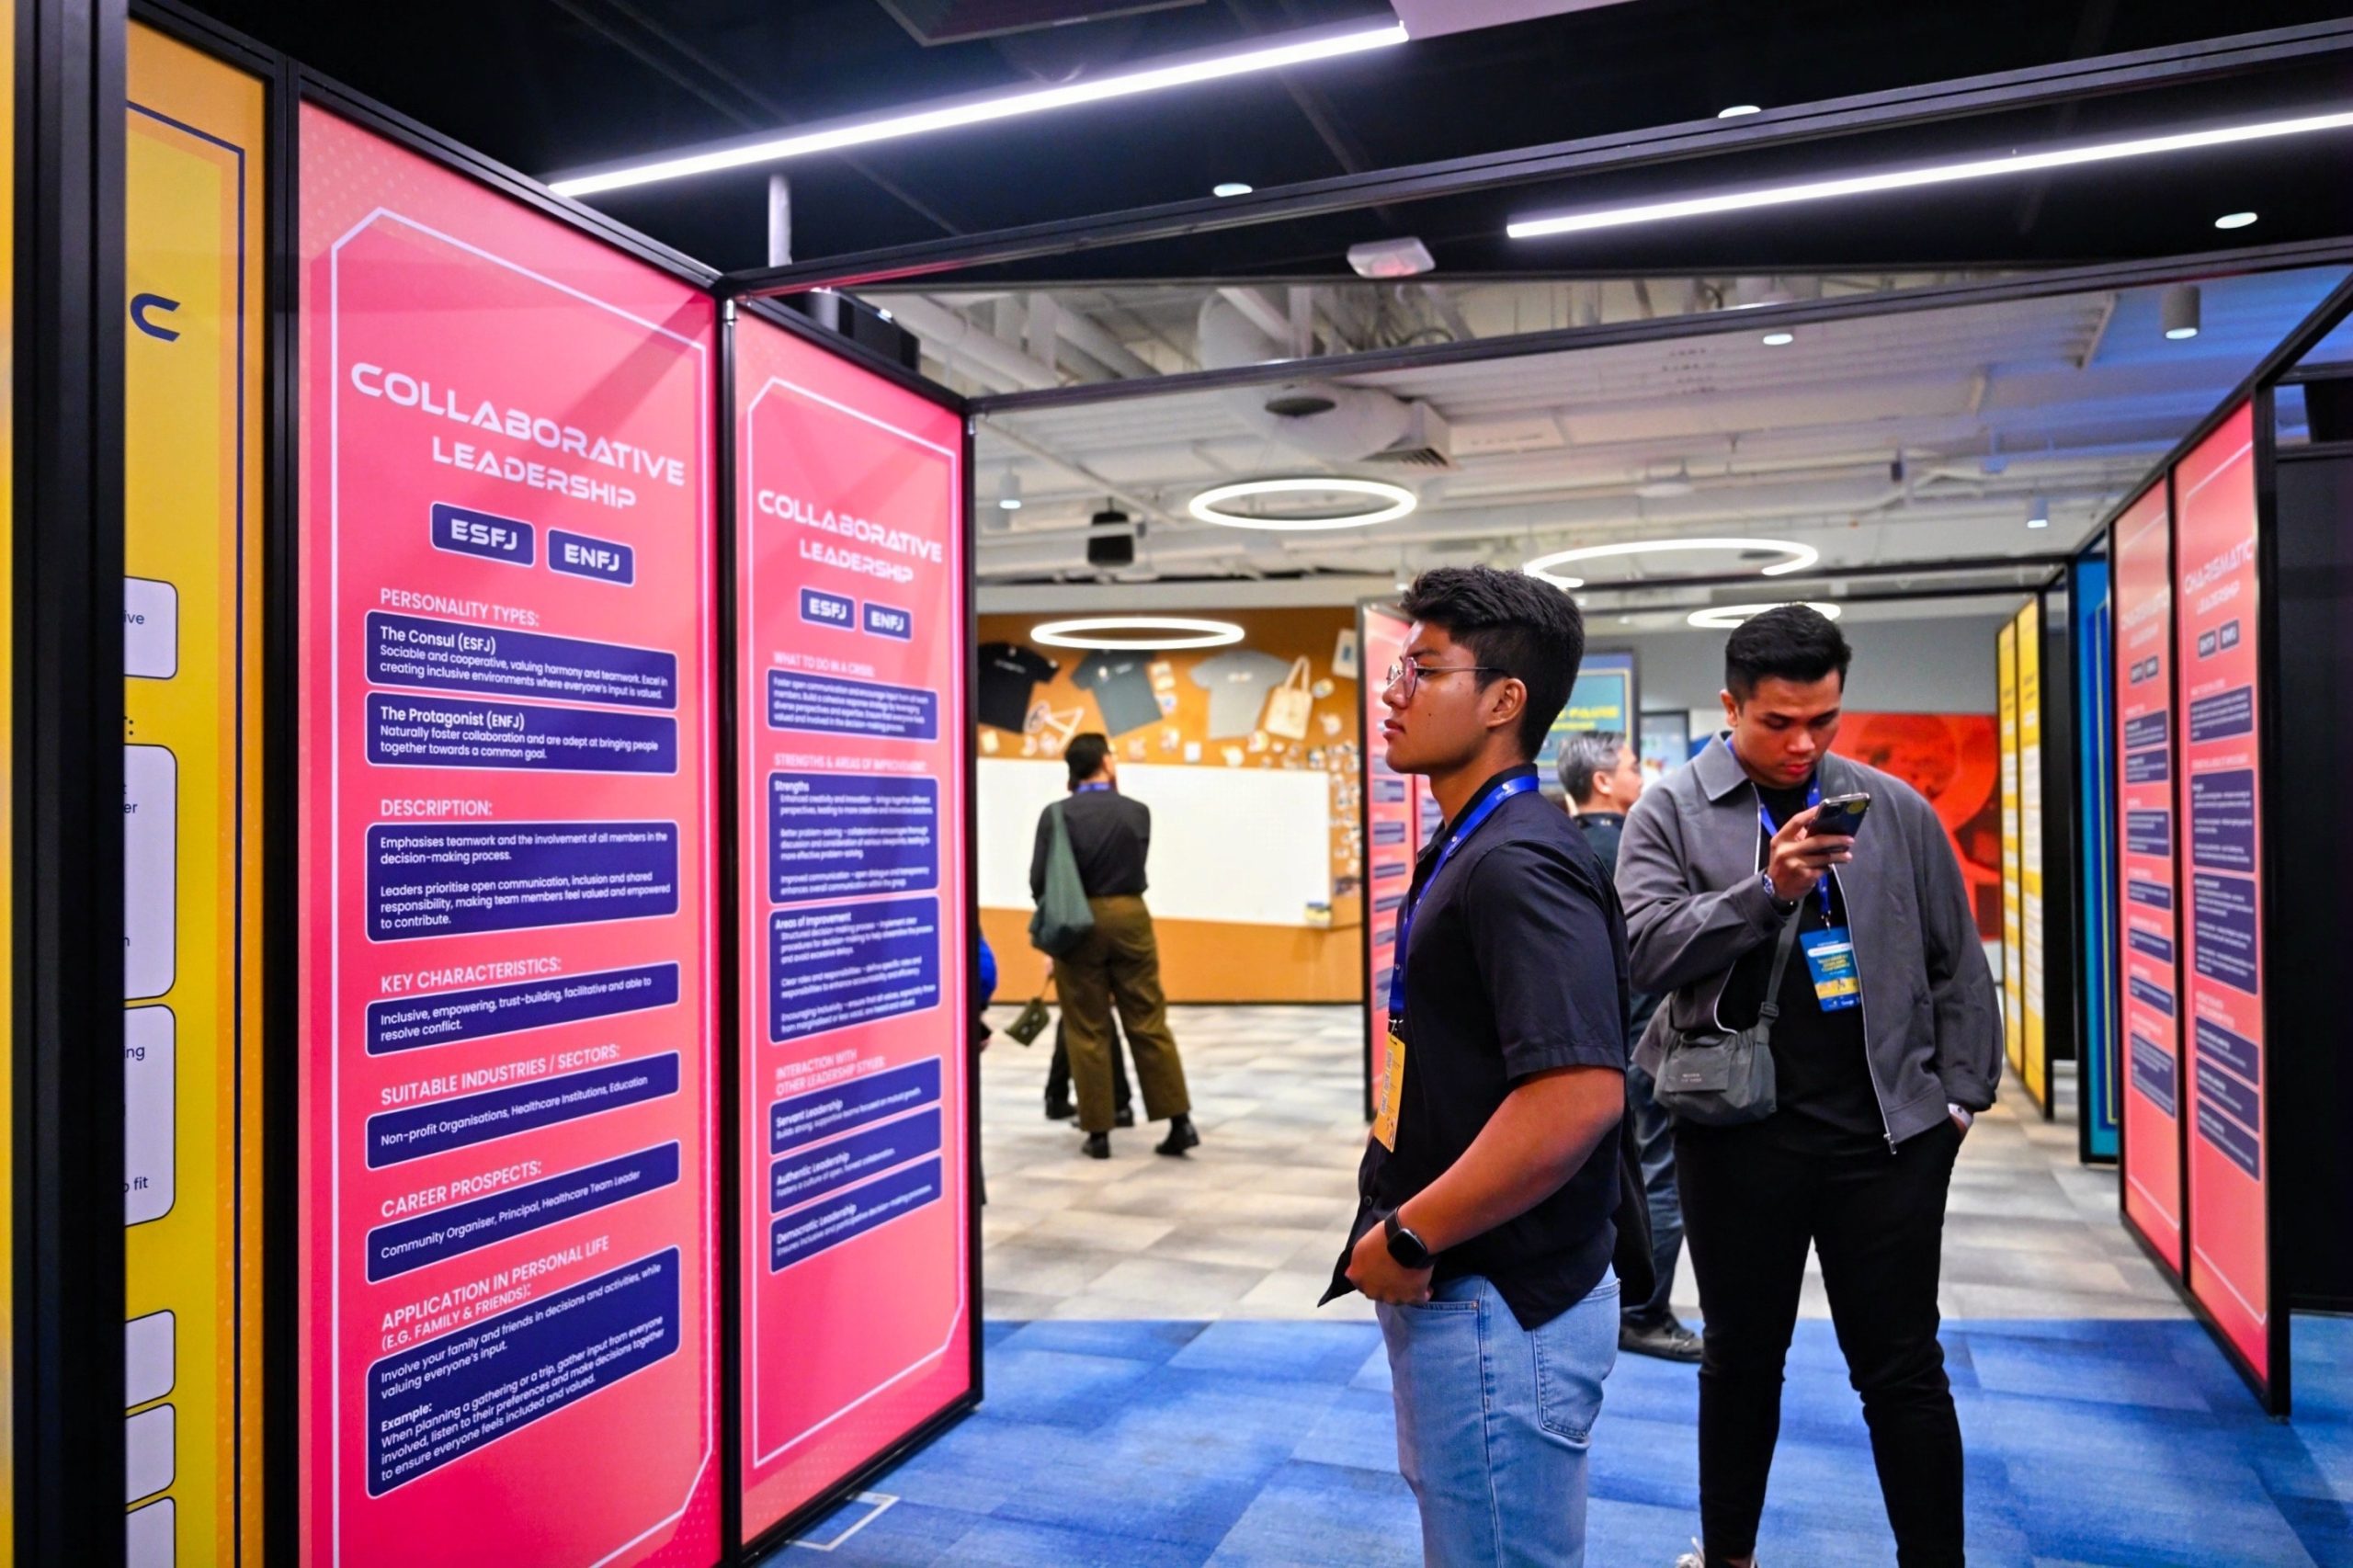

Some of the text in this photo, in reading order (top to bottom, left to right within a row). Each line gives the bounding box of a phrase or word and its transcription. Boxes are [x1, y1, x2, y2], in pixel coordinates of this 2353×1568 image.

[351, 362, 686, 486] COLLABORATIVE
[433, 436, 636, 509] LEADERSHIP
[757, 490, 942, 562] COLLABORATIVE
[450, 518, 620, 572] ESFJ ENFJ
[800, 539, 914, 583] LEADERSHIP
[381, 587, 539, 626] PERSONALITY TYPES:
[809, 598, 904, 631] ESFJ ENFJ
[380, 625, 495, 654] The Consul (ESFJ)
[380, 644, 582, 679] Sociable and cooperative, valuing harmony
[380, 662, 424, 678] creating
[426, 665, 470, 679] inclusive
[472, 671, 534, 686] environments
[536, 677, 562, 688] where
[380, 706, 524, 731] The Protagonist (ENFJ)
[381, 724, 429, 740] Naturally
[431, 727, 460, 739] foster
[462, 730, 524, 743] collaboration
[527, 733, 544, 744] and
[546, 736, 561, 744] are
[381, 741, 547, 760] together towards a common goal.
[775, 780, 809, 793] Strengths
[381, 800, 492, 815] DESCRIPTION:
[381, 835, 444, 850] Emphasises
[446, 835, 495, 846] teamwork
[497, 834, 516, 845] and
[517, 834, 532, 844] the
[534, 834, 586, 844] involvement
[381, 850, 511, 864] decision-making process.
[381, 884, 423, 896] Leaders
[426, 881, 469, 896] prioritise
[471, 881, 495, 893] open
[497, 876, 570, 889] communication,
[381, 897, 453, 915] responsibility,
[455, 895, 492, 908] making
[494, 894, 518, 904] team
[521, 891, 563, 903] members
[380, 914, 450, 928] to contribute.
[775, 911, 851, 929] Areas of Improvement
[381, 957, 561, 992] KEY CHARACTERISTICS:
[381, 983, 607, 1025] Inclusive, empowering, trust-building, facilitative
[381, 1019, 462, 1041] resolve conflict.
[381, 1044, 619, 1104] SUITABLE INDUSTRIES / SECTORS:
[381, 1123, 437, 1146] Non-profit
[438, 1108, 509, 1132] Organisations,
[511, 1096, 560, 1115] Healthcare
[562, 1086, 608, 1103] Institutions,
[776, 1098, 842, 1127] Servant Leadership
[133, 1176, 149, 1190] fit
[777, 1165, 812, 1186] Authentic
[813, 1151, 848, 1172] Leadership
[381, 1160, 540, 1216] CAREER PROSPECTS:
[381, 1232, 444, 1258] Community
[447, 1215, 496, 1237] Organiser,
[499, 1200, 540, 1221] Principal,
[542, 1187, 588, 1208] Healthcare
[777, 1203, 856, 1244] Democratic Leadership
[381, 1235, 608, 1331] APPLICATION IN PERSONAL LIFE
[381, 1282, 530, 1352] (E.G. FAMILY & FRIENDS):
[381, 1360, 419, 1383] Involve
[422, 1349, 445, 1369] your
[448, 1336, 479, 1356] family
[481, 1326, 499, 1342] and
[502, 1314, 533, 1335] friends
[535, 1311, 542, 1321] in
[545, 1295, 585, 1316] decisions
[381, 1375, 421, 1399] valuing
[480, 1340, 506, 1358] input.
[381, 1427, 412, 1448] When
[415, 1405, 460, 1437] planning
[462, 1402, 469, 1411] a
[472, 1381, 517, 1410] gathering
[519, 1375, 529, 1385] or
[530, 1371, 537, 1381] a
[539, 1365, 555, 1377] trip,
[557, 1350, 585, 1371] gather
[381, 1435, 428, 1465] involved,
[431, 1423, 458, 1442] listen
[460, 1417, 470, 1427] to
[472, 1405, 494, 1422] their
[496, 1381, 550, 1415] preferences
[551, 1370, 568, 1386] and
[570, 1361, 593, 1378] make
[381, 1403, 431, 1432] Example:
[381, 1372, 595, 1481] to ensure everyone feels included and valued.
